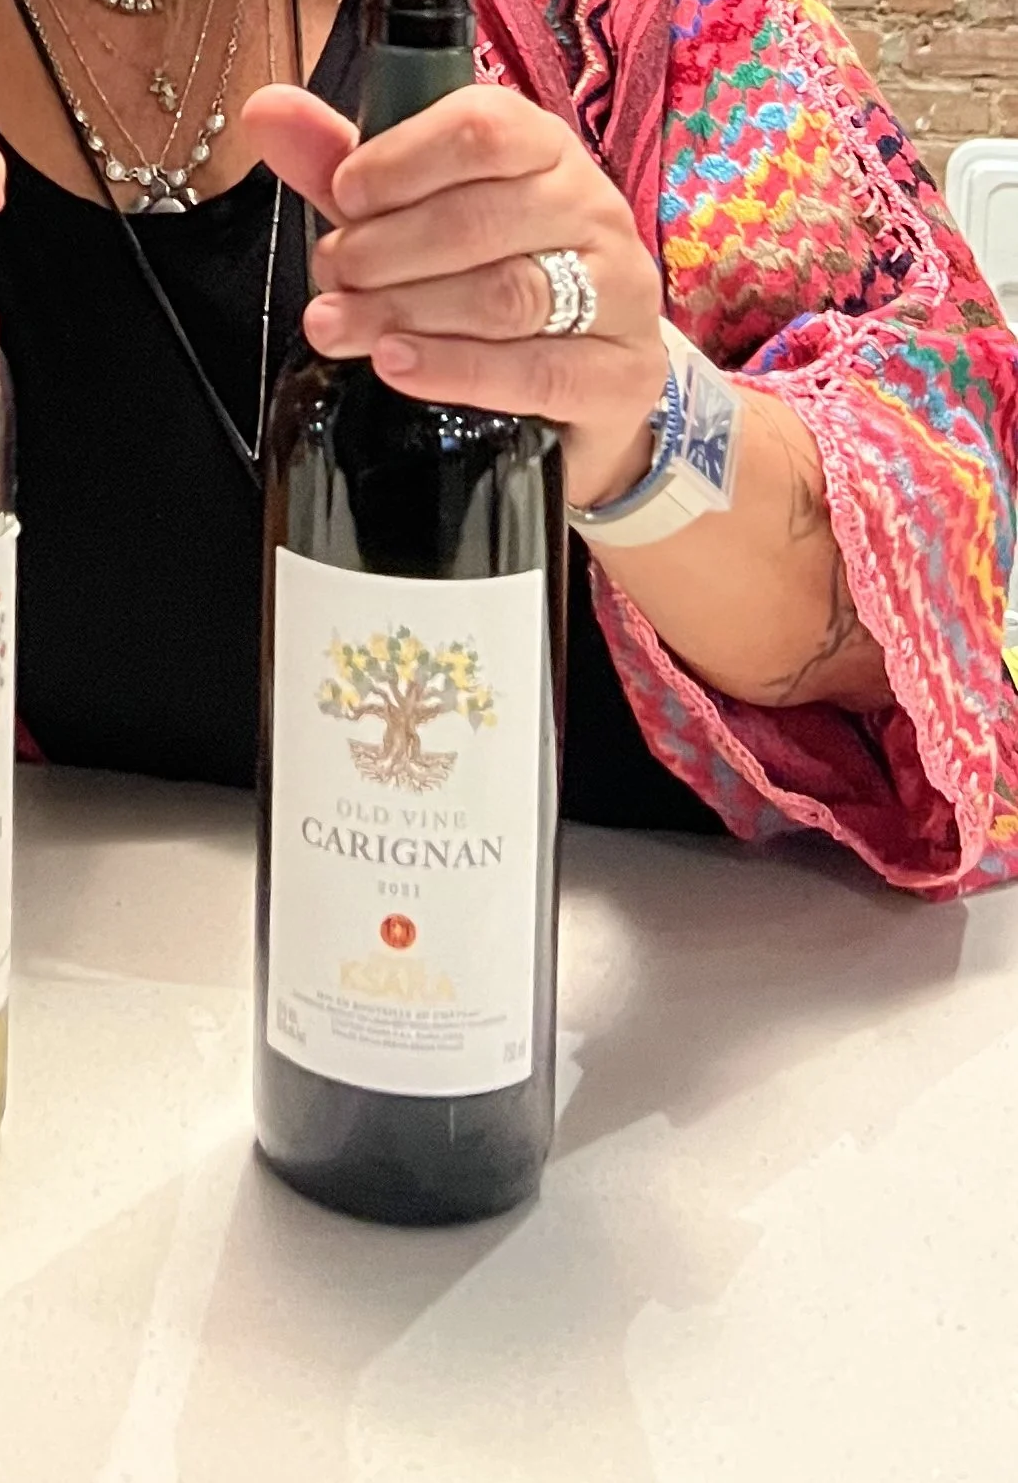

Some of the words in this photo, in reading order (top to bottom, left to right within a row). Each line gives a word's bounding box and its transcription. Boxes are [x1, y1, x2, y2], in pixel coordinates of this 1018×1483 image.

[336, 796, 391, 825] OLD
[401, 808, 469, 830] VINE
[301, 815, 504, 869] CARIGNAN
